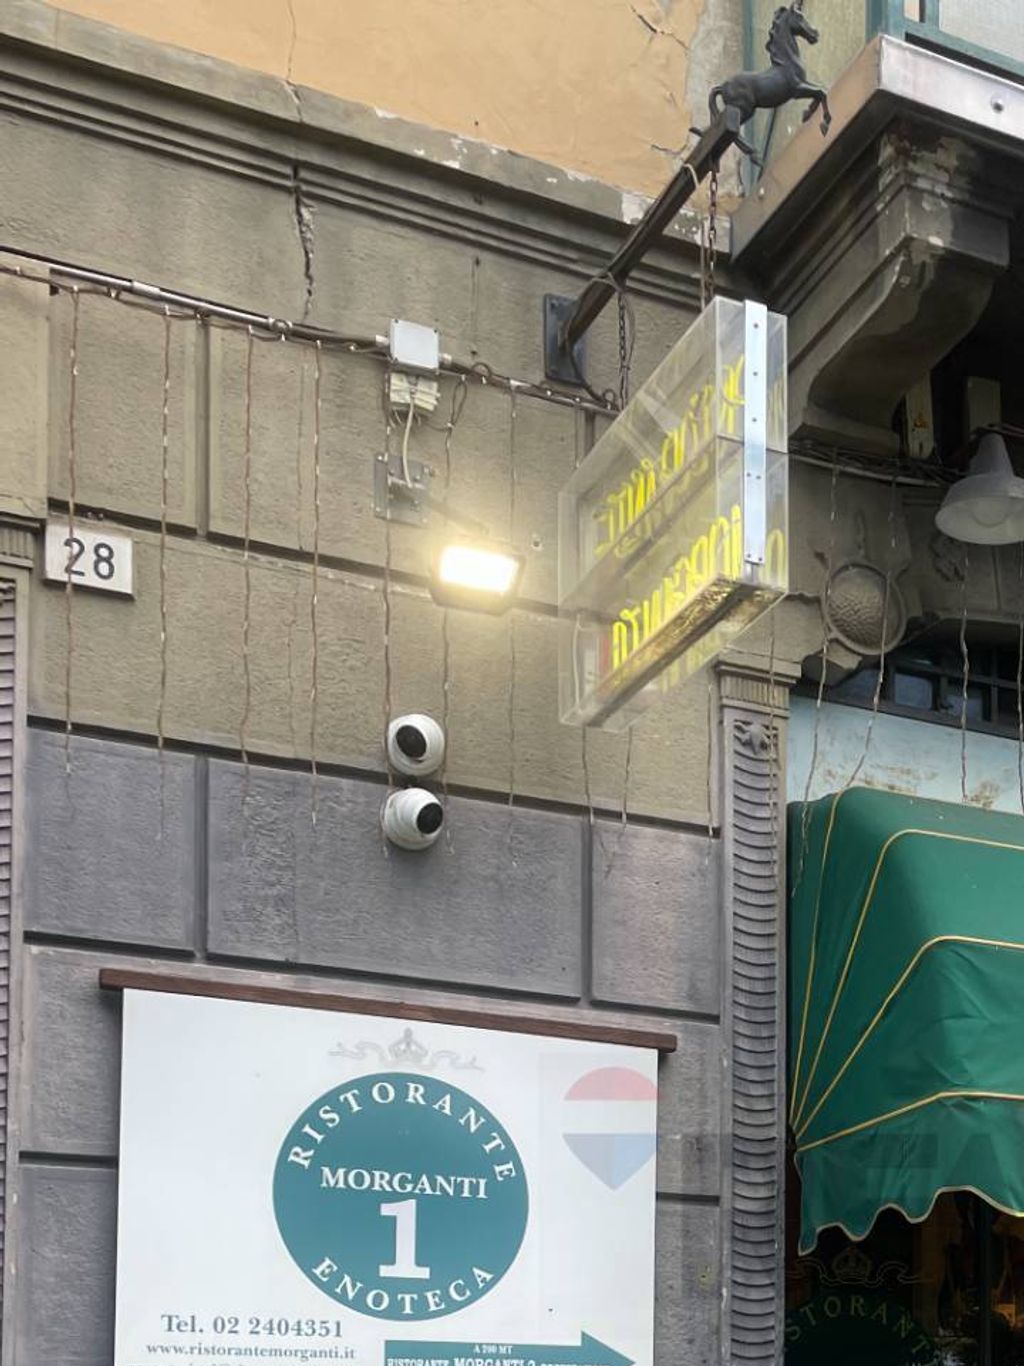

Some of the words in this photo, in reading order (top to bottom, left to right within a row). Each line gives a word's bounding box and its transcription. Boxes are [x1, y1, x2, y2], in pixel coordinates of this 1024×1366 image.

[64, 537, 115, 581] 28
[288, 1082, 516, 1182] RISTORANTE
[320, 1166, 488, 1199] MORGANTI
[379, 1199, 430, 1279] 1
[312, 1257, 494, 1314] ENOTECA
[160, 1314, 205, 1334] Tel.
[213, 1316, 240, 1335] 02
[249, 1316, 343, 1338] 2404351
[146, 1342, 355, 1362] www.ristorantemorganti.it
